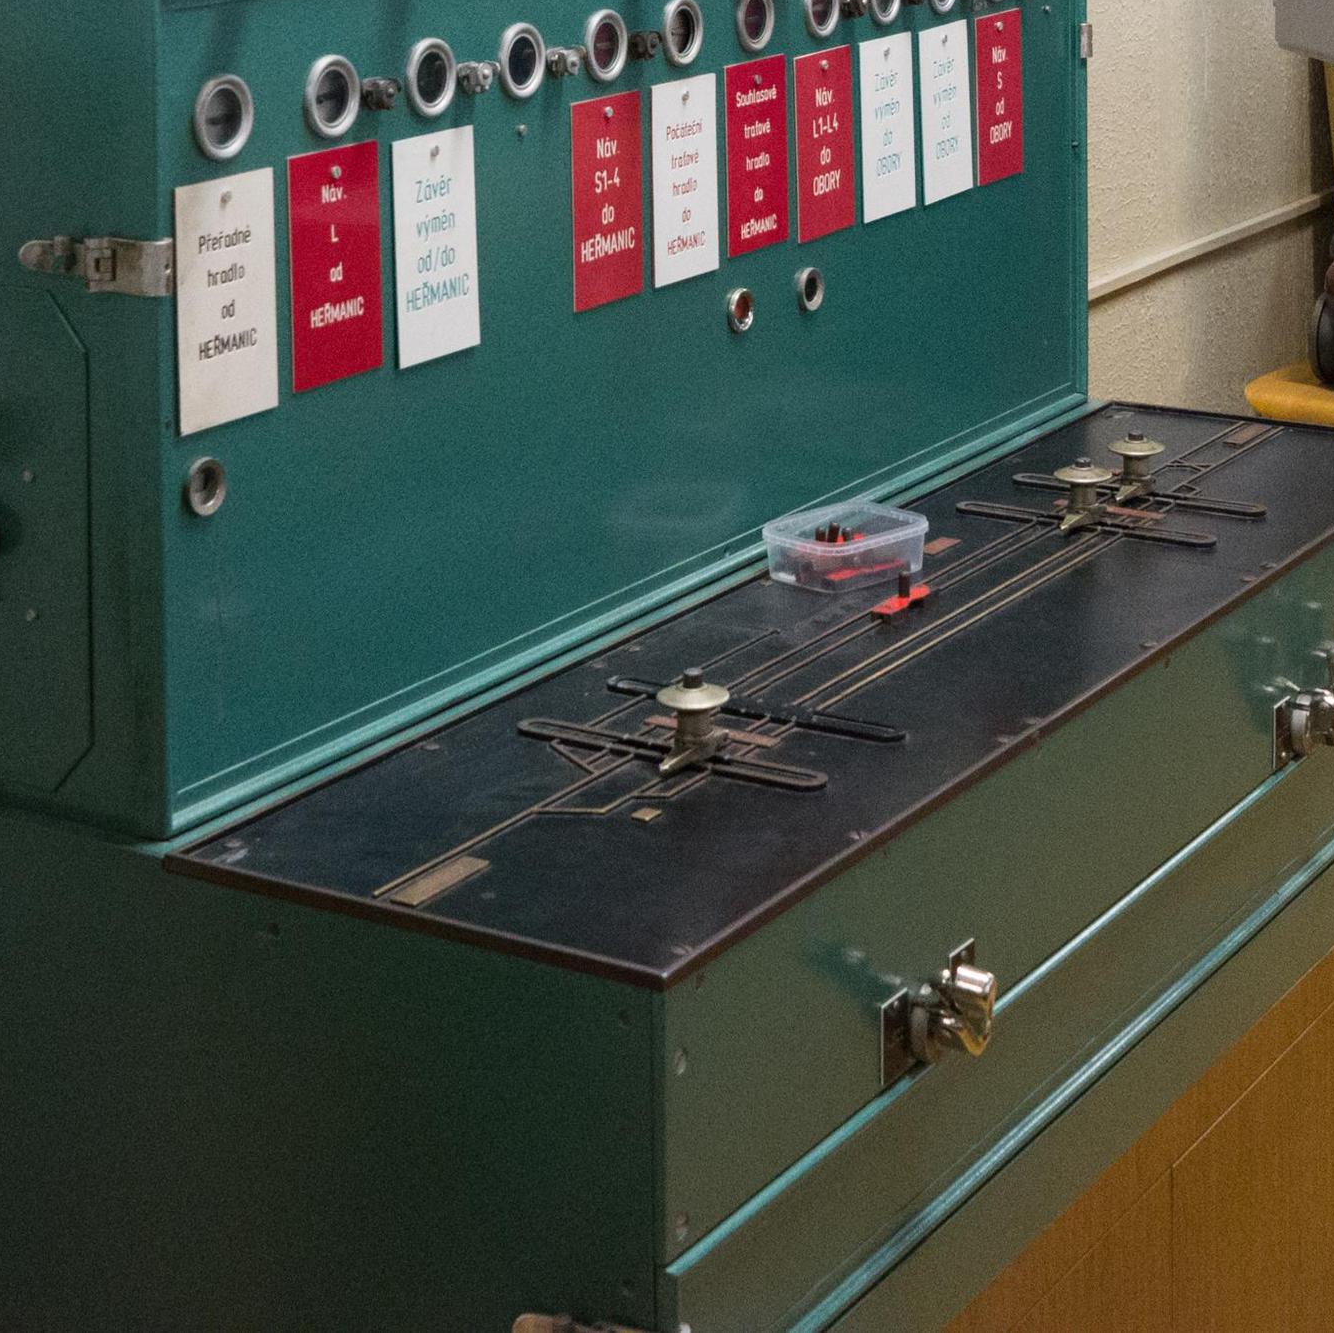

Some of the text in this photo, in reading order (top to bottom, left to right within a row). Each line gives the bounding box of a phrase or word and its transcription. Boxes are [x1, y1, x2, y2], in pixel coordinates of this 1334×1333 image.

[992, 46, 1008, 64] Náv.
[996, 71, 1004, 90] S
[736, 84, 777, 108] Souhlasové
[815, 87, 836, 108] Náv.
[995, 98, 1005, 116] od
[666, 118, 703, 141] Počáteční
[812, 113, 839, 139] L1-L4
[989, 121, 1013, 145] OBORY
[596, 138, 620, 159] Náv.
[883, 129, 893, 148] do
[935, 136, 959, 160] OBORY
[746, 151, 770, 171] hradlo
[820, 145, 831, 166] do
[876, 152, 902, 177] OBORY
[415, 175, 452, 204] Závěr
[594, 167, 620, 194] S1-4
[672, 177, 698, 197] hradlo
[812, 169, 841, 196] OBORY
[321, 183, 347, 204] Náv.
[753, 186, 764, 203] do
[601, 204, 615, 225] do
[681, 207, 691, 224] do
[330, 224, 339, 243] L
[416, 211, 455, 242] výměn
[740, 214, 778, 240] HEŘMANIC
[198, 227, 251, 255] Přeřadné
[581, 226, 636, 263] HEŘMANIC
[666, 230, 706, 256] HEŘMANIC
[207, 264, 246, 288] hradlo
[330, 261, 343, 282] od
[405, 273, 470, 313] HEŘMANIC
[221, 299, 235, 320] od
[310, 296, 365, 329] HEŘMANIC
[198, 327, 258, 361] HEŘMANIC
